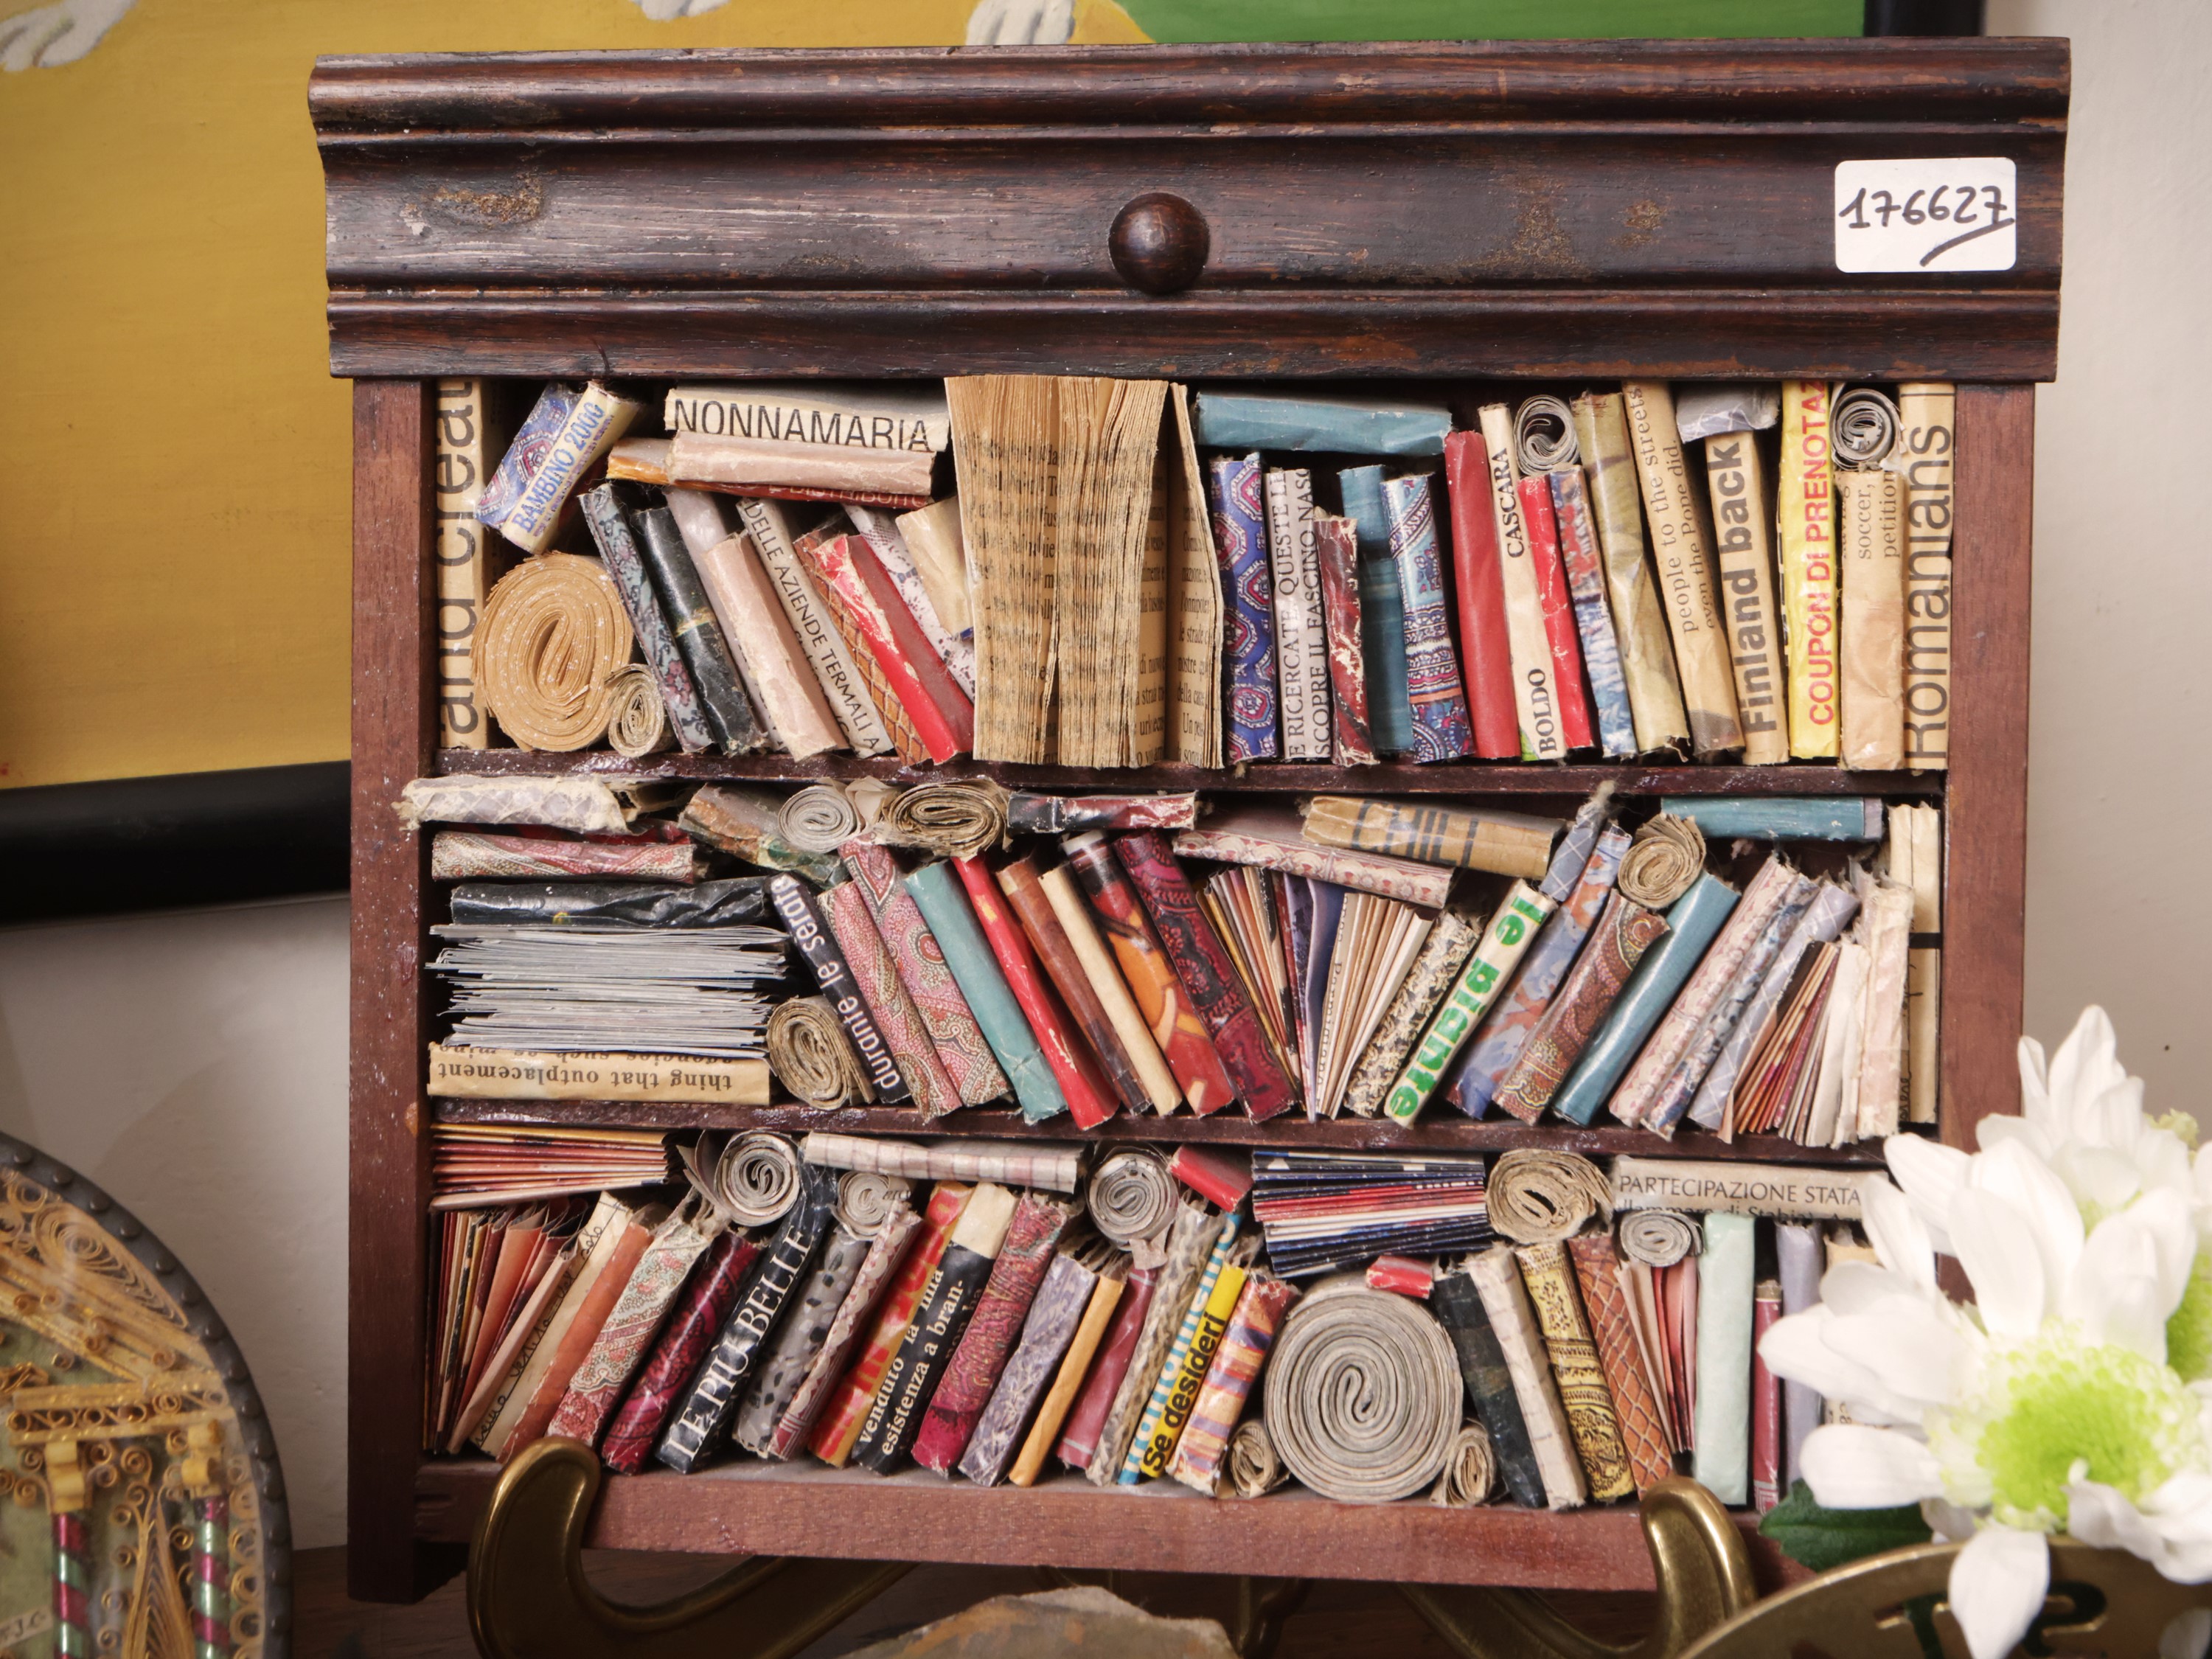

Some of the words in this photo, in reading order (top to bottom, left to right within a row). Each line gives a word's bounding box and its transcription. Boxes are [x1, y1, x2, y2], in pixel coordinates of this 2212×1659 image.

[1839, 185, 2008, 229] 176627
[674, 399, 932, 451] NONNAMARIA
[1629, 386, 1658, 467] streets
[512, 448, 576, 532] BAMBINO
[1492, 448, 1525, 558] CASCARA
[1650, 476, 1669, 513] the
[1708, 441, 1753, 554] back
[1858, 484, 1876, 560] soccer,
[1272, 504, 1298, 596] QUESTE
[1661, 523, 1677, 547] to
[1689, 542, 1704, 575] the
[1806, 552, 1830, 581] DI
[744, 501, 784, 560] DELLE
[774, 566, 828, 648] AZIENDE
[821, 647, 872, 731] TERMALI
[1300, 529, 1323, 630] FASCINO
[1666, 557, 1699, 634] people
[1281, 611, 1304, 737] RICERCATE
[1309, 637, 1325, 658] IL
[1722, 567, 1777, 734] Finland
[1807, 592, 1834, 726] COUPON
[1289, 744, 1305, 757] E
[1310, 667, 1330, 755] SCOPRE
[1527, 668, 1557, 754] BOLDO
[1495, 895, 1548, 945] le
[816, 959, 840, 989] le
[439, 1062, 599, 1090] outplacement
[611, 1067, 658, 1088] that
[838, 995, 901, 1091] durante
[1391, 957, 1501, 1117] piante
[670, 1068, 733, 1091] thing
[1621, 1175, 1798, 1202] PARTECIPAZIONE
[667, 1402, 714, 1464] LE
[693, 1335, 751, 1412] PIÙ
[735, 1230, 812, 1342] BELLE
[881, 1360, 931, 1457] esistenza
[926, 1343, 939, 1358] a
[933, 1279, 964, 1340] bran-
[1143, 1438, 1172, 1472] Se
[1164, 1312, 1225, 1427] desideri
